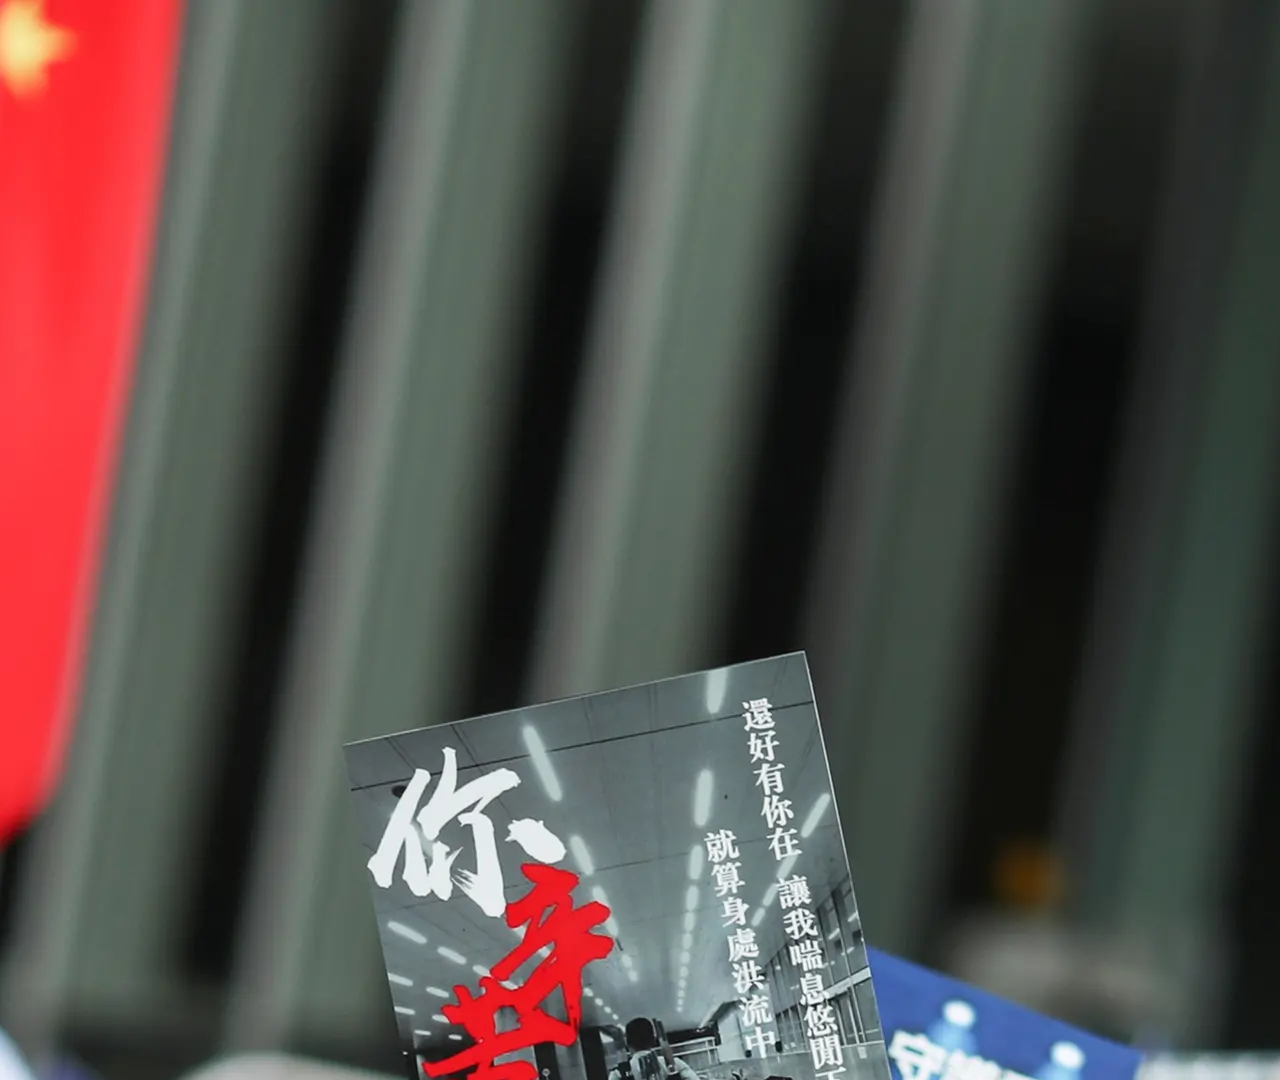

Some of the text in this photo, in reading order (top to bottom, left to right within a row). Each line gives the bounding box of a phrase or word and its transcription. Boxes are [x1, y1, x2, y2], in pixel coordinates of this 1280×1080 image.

[742, 698, 802, 861] 還好有你在
[704, 829, 776, 1059] 就算身處洪流中
